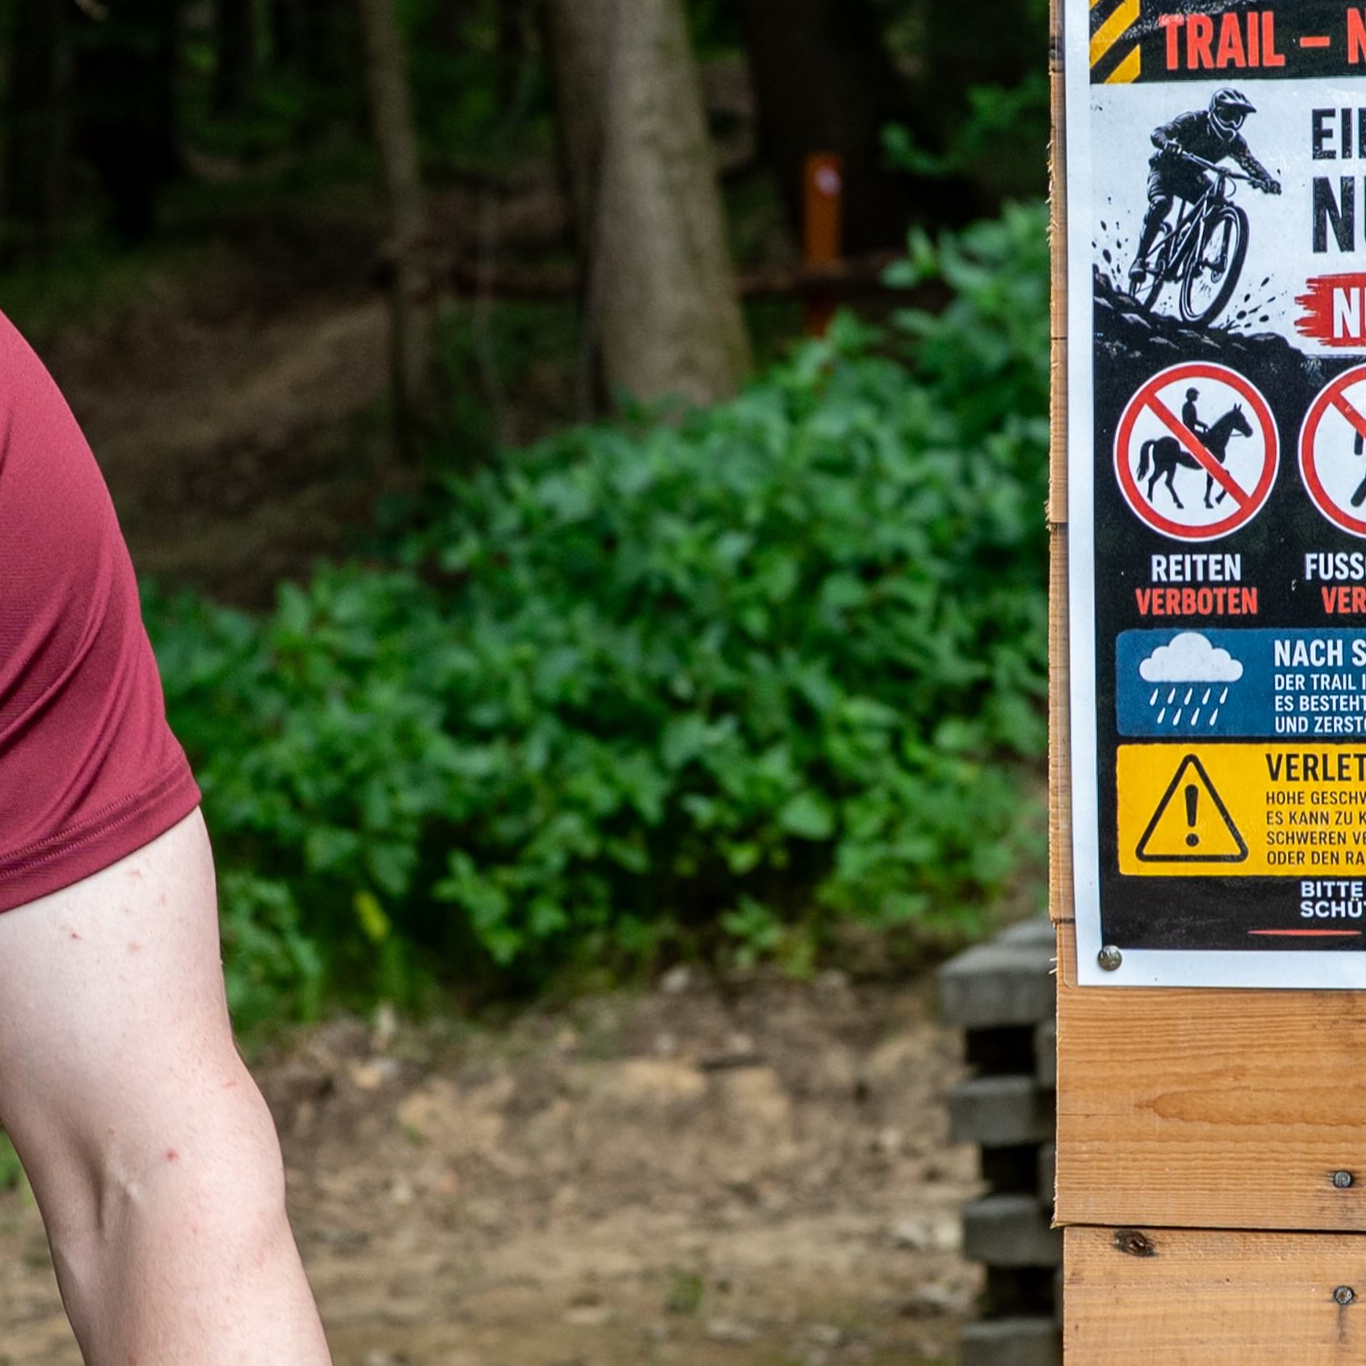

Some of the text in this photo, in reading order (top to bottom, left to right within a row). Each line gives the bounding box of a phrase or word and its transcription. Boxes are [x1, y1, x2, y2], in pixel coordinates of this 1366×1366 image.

[1159, 13, 1285, 70] TRAIL
[1152, 554, 1240, 581] REITEN
[1136, 587, 1257, 615] VERBOTEN
[1275, 640, 1343, 666] NACH
[1275, 674, 1305, 690] DER
[1310, 674, 1356, 690] TRAIL
[1275, 696, 1293, 711] ES
[1276, 717, 1308, 733] UND
[1266, 791, 1304, 805] HOHE
[1267, 811, 1283, 825] ES
[1289, 811, 1329, 825] KANN
[1335, 811, 1352, 825] ZU
[1267, 831, 1346, 845] SCHWEREN
[1267, 851, 1305, 865] ODER
[1311, 851, 1339, 865] DEN
[1301, 882, 1363, 899] BITTE
